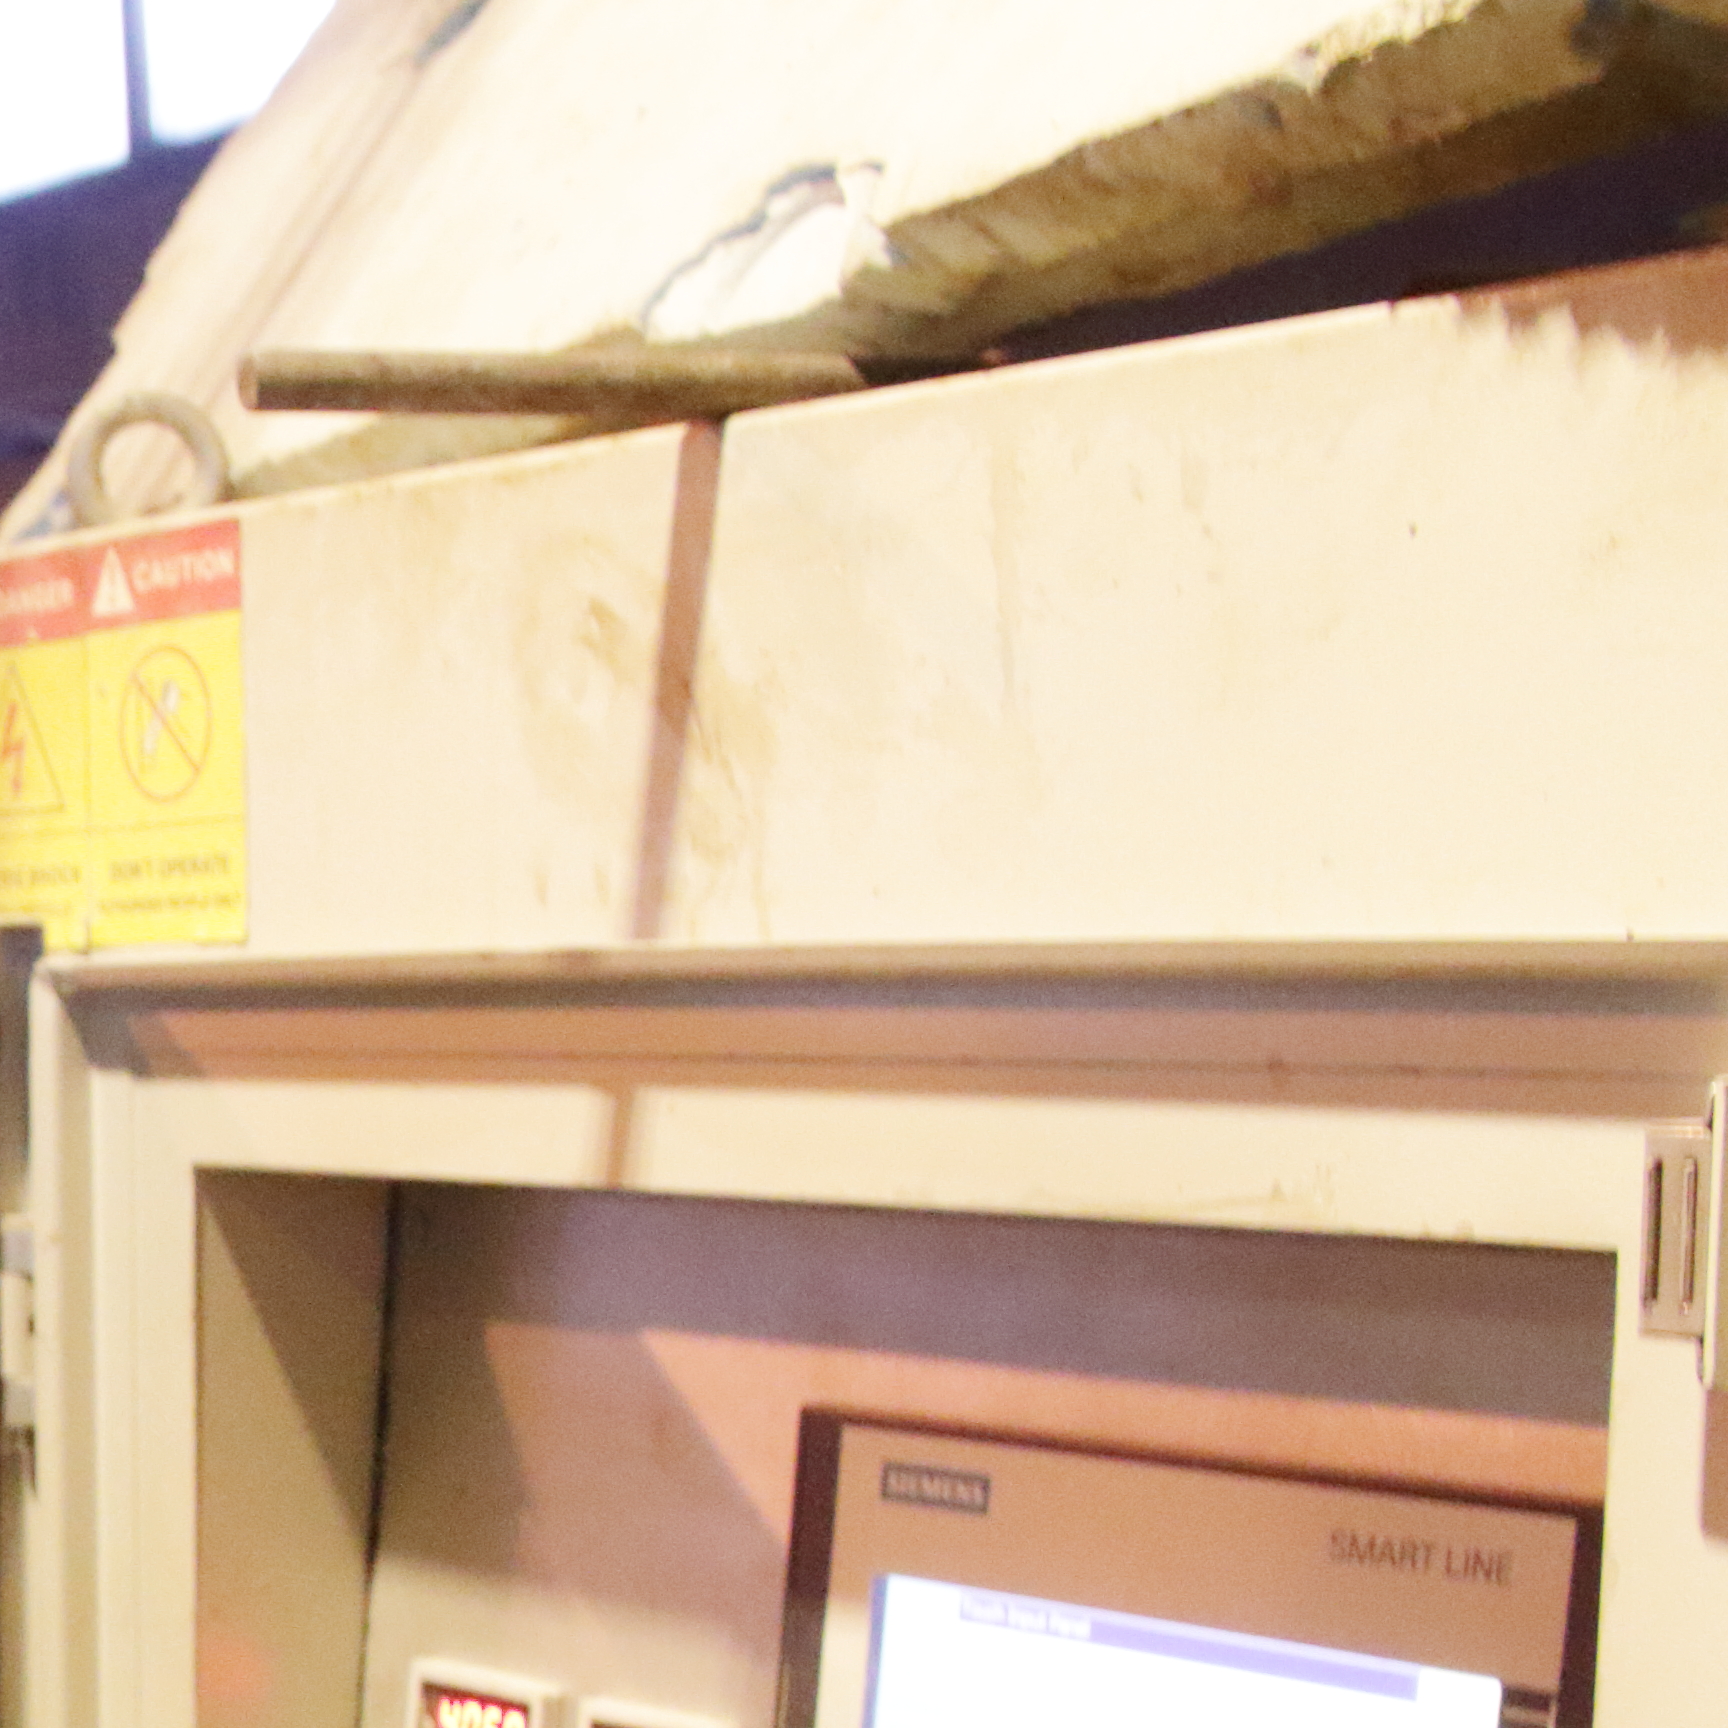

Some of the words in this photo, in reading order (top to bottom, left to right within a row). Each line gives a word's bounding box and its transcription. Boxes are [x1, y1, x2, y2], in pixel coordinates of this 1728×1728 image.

[132, 549, 235, 595] CAUTION
[1329, 1528, 1435, 1573] SMART
[1444, 1545, 1513, 1587] LINE
